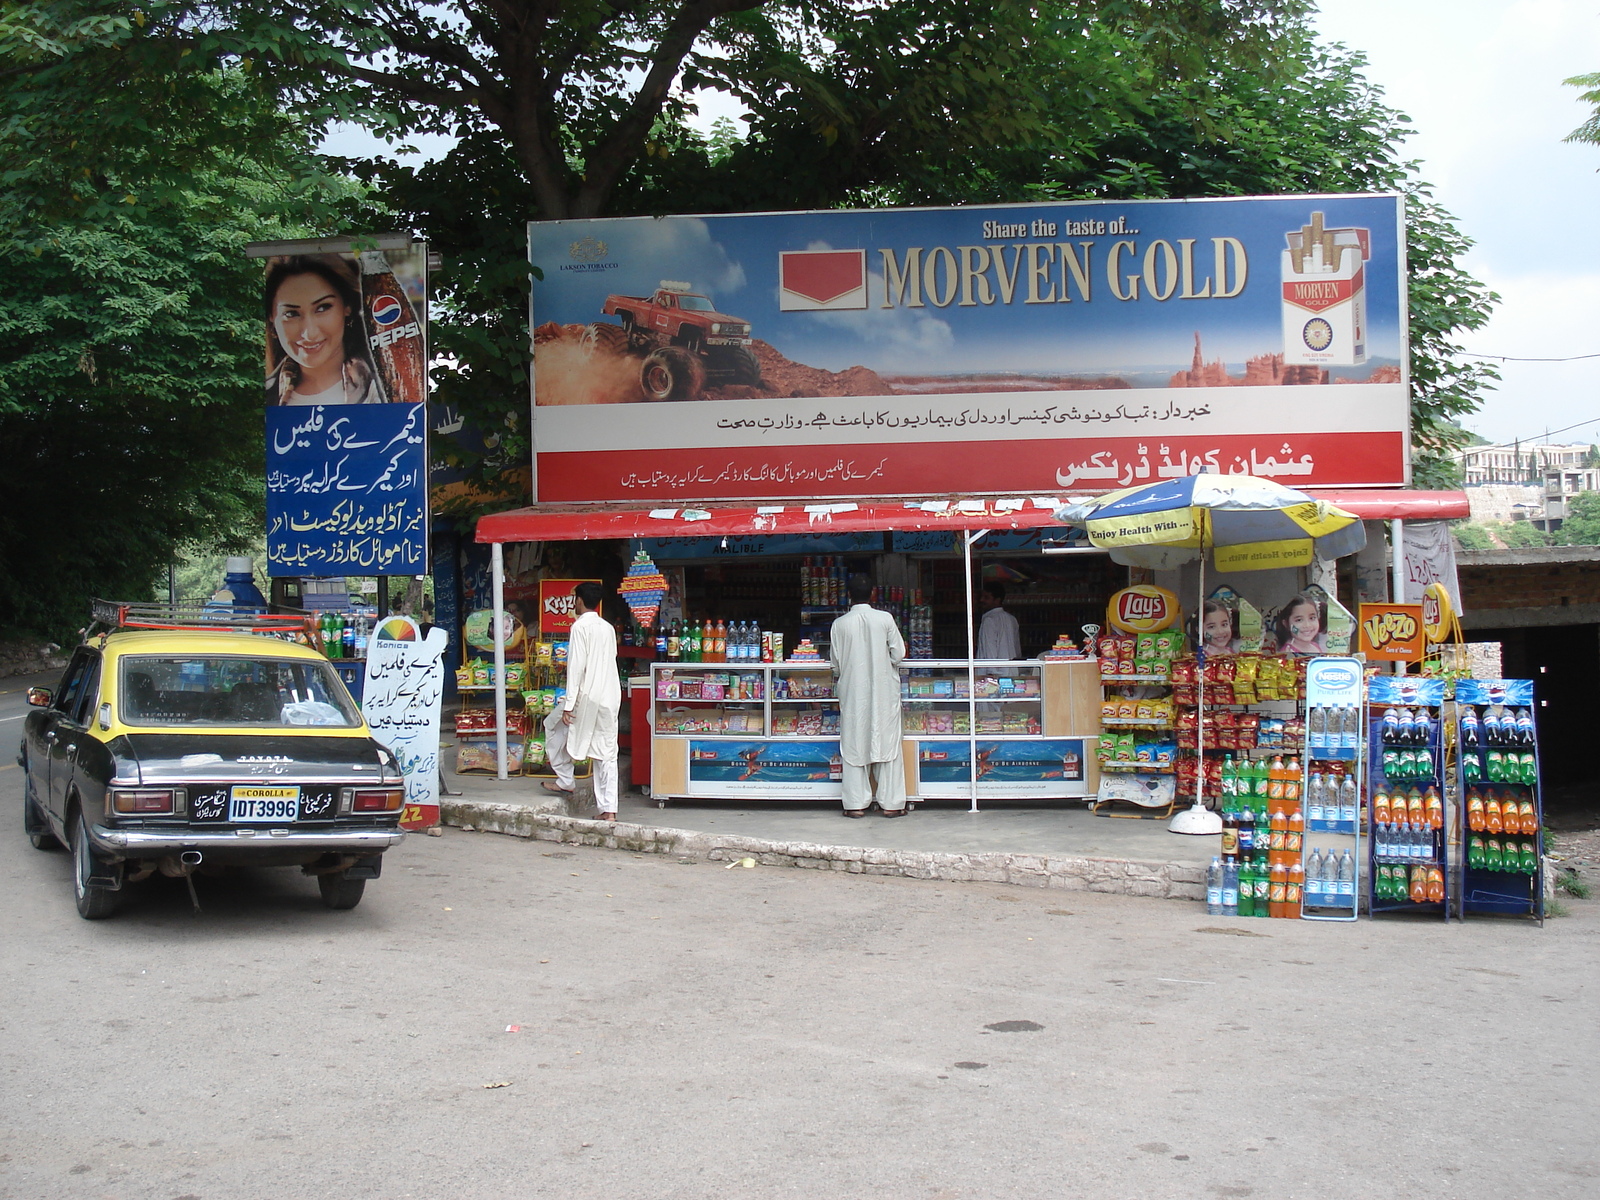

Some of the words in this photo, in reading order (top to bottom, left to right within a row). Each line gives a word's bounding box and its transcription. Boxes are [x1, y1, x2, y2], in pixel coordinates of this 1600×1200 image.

[983, 221, 1027, 239] Share
[1031, 219, 1056, 237] the
[1066, 219, 1105, 236] taste
[878, 242, 1094, 309] MORVEN
[1107, 236, 1248, 301] GOLD
[1295, 282, 1339, 299] MORVEN
[369, 322, 420, 350] PEPSI
[717, 417, 755, 429] صحت
[832, 411, 873, 429] باعث
[877, 411, 889, 426] کا
[954, 410, 970, 427] کی
[969, 408, 987, 425] دل
[990, 408, 1011, 425] اور
[1016, 406, 1057, 425] کینسر
[274, 405, 324, 454] فلمیں
[327, 417, 350, 451] کی
[851, 458, 888, 480] کیمرے
[1056, 442, 1151, 487] ڈرنکس
[1158, 443, 1221, 478] کولڈ
[1228, 442, 1314, 477] عثمان
[336, 449, 408, 495] کیمرے
[394, 469, 418, 491] اور
[698, 461, 734, 485] کیمرے
[776, 461, 806, 483] موبائل
[804, 468, 818, 479] اور
[817, 459, 843, 481] فلمیں
[842, 460, 855, 481] کی
[621, 473, 637, 488] ہیں
[403, 507, 424, 533] نیز
[1091, 530, 1117, 540] Enjoy
[1119, 526, 1152, 537] Health
[1154, 521, 1178, 533] With
[401, 538, 423, 564] تمام
[377, 641, 409, 650] Konica
[370, 652, 405, 680] فلمیں
[1478, 682, 1507, 690] PEPSI
[392, 712, 430, 730] دستیاب
[389, 730, 417, 745] نیز
[246, 789, 284, 797] COROLLA
[232, 800, 296, 818] IDT3996
